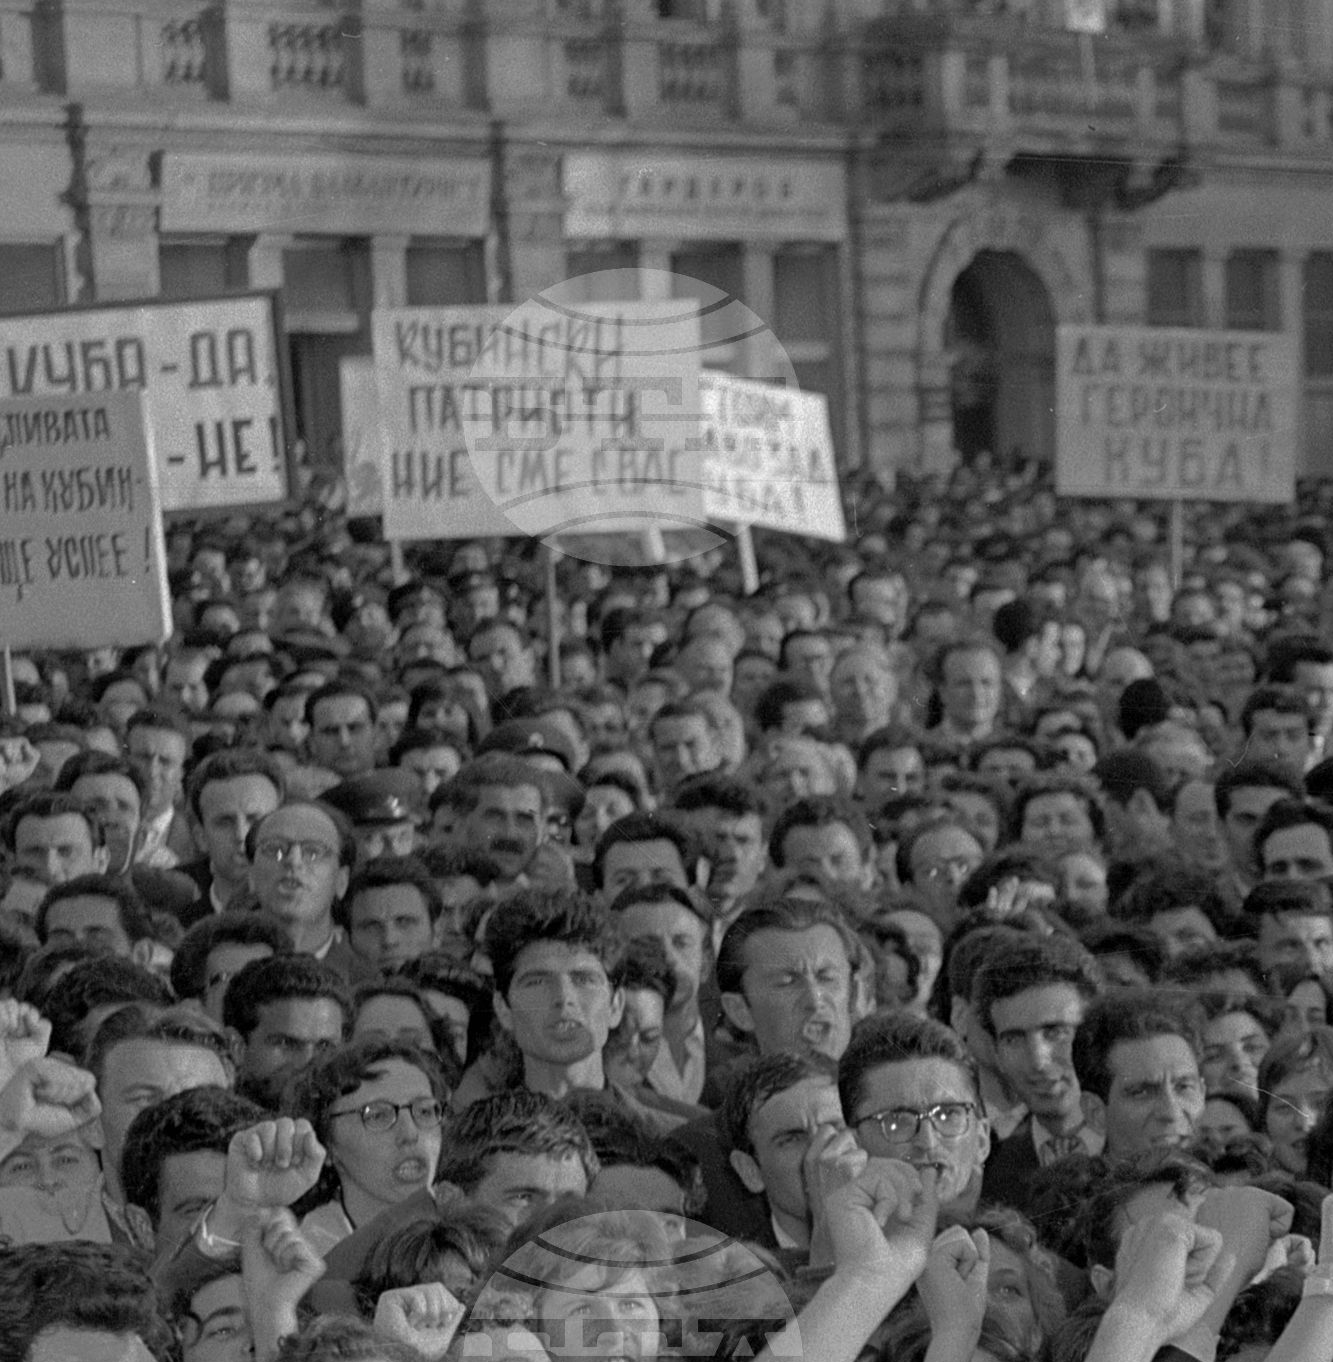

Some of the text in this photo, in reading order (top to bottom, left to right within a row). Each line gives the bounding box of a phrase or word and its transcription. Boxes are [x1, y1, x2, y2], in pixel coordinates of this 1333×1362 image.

[1072, 337, 1266, 383] ДА ЖИВЕЕ
[0, 406, 110, 452] ЛИВАТА
[391, 449, 471, 499] НИЕ
